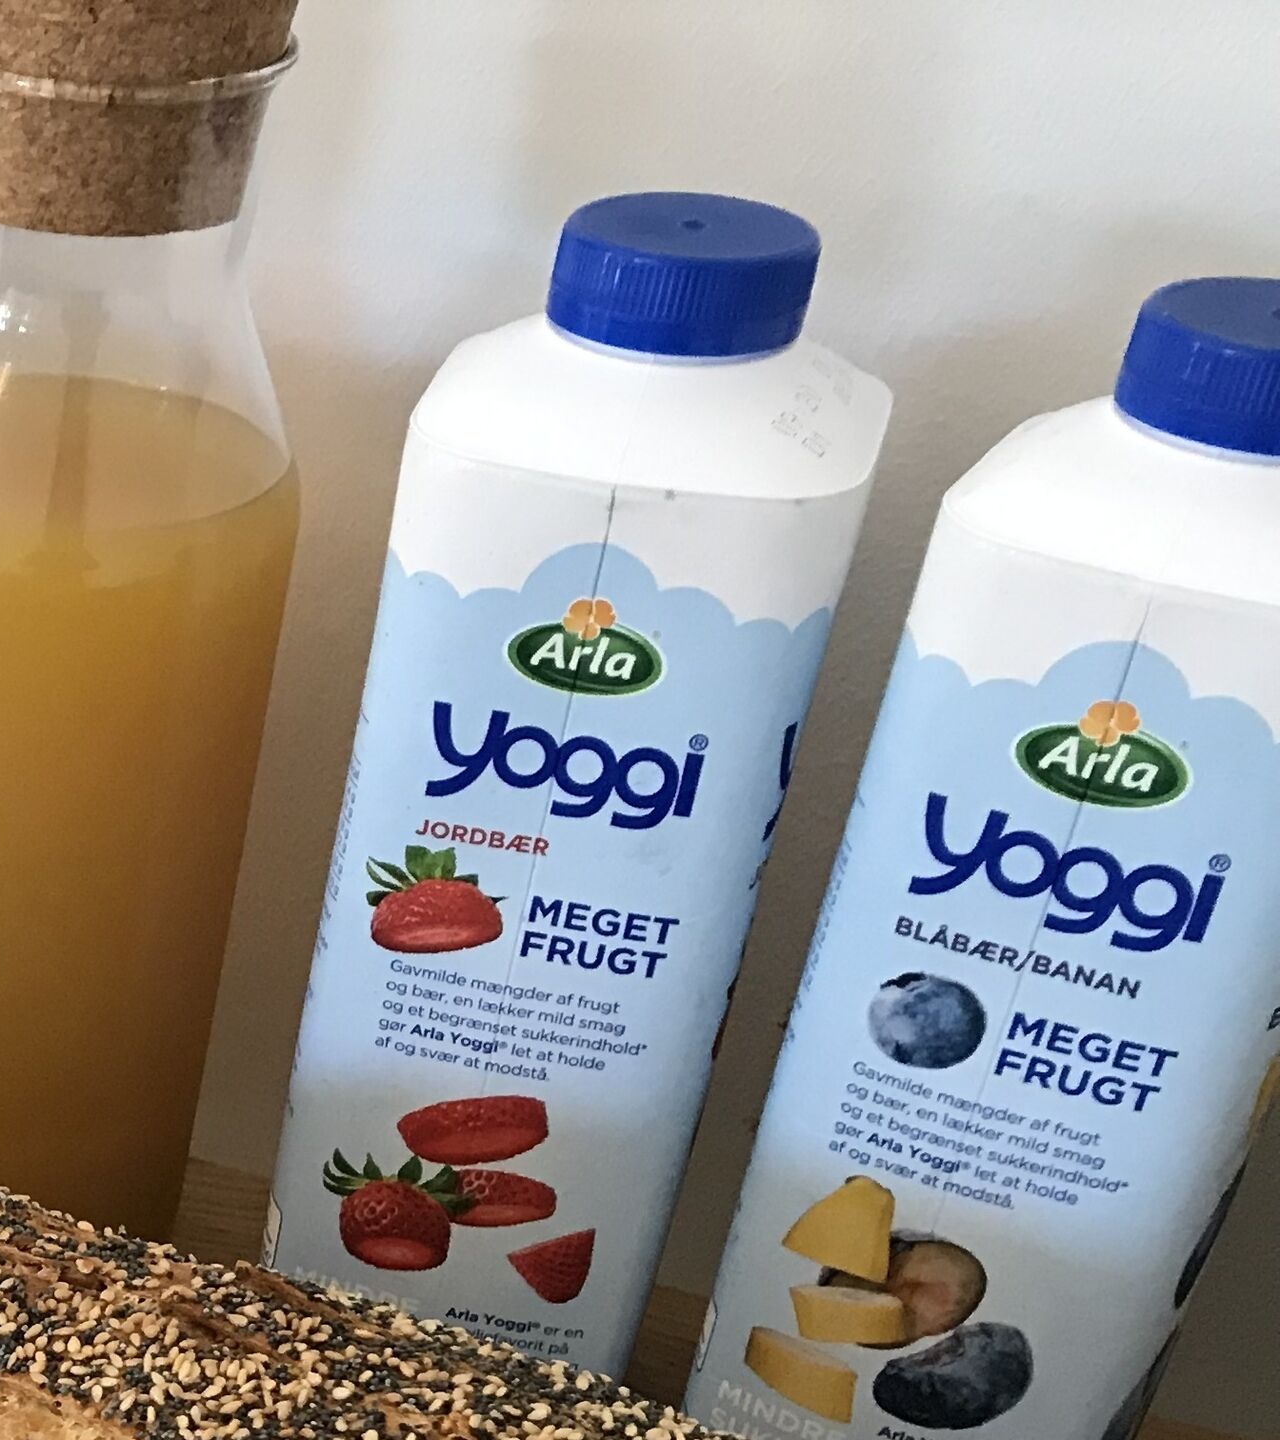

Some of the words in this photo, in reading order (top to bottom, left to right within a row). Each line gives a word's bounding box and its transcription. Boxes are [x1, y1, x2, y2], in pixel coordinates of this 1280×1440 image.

[529, 633, 638, 682] Arla
[1038, 735, 1160, 793] Arla
[415, 819, 550, 856] JORDBÆR
[527, 895, 680, 945] MEGET
[519, 932, 668, 979] FRUGT
[894, 915, 1143, 1000] BLÅBÆR/BANAN
[385, 981, 408, 996] og
[412, 984, 448, 1005] bær,
[453, 994, 473, 1008] en
[477, 997, 535, 1020] lækker
[538, 1009, 575, 1027] mild
[579, 1018, 626, 1037] smag
[390, 959, 467, 987] Gavmilde
[470, 976, 553, 1002] mængder
[556, 993, 575, 1006] af
[577, 997, 620, 1016] frugt
[378, 1018, 406, 1033] gør
[410, 1024, 445, 1042] Arla
[511, 1043, 532, 1059] let
[536, 1049, 554, 1063] at
[557, 1052, 606, 1071] holde
[382, 999, 403, 1015] og
[408, 1003, 425, 1018] et
[429, 1007, 517, 1037] begrænset
[1007, 1012, 1179, 1078] MEGET
[374, 1036, 393, 1048] af
[394, 1040, 416, 1056] og
[419, 1046, 461, 1064] svær
[463, 1055, 481, 1070] at
[484, 1060, 549, 1082] modstå.
[993, 1047, 1162, 1112] FRUGT
[840, 1101, 863, 1120] og
[866, 1108, 885, 1126] et
[887, 1116, 984, 1159] begrænset
[846, 1082, 869, 1101] og
[871, 1087, 911, 1116] bær,
[916, 1106, 938, 1123] en
[941, 1112, 1005, 1141] lækker
[1008, 1132, 1049, 1155] mild
[1052, 1146, 1106, 1171] smag
[853, 1060, 933, 1100] Gavmilde
[936, 1090, 1026, 1126] mængder
[1029, 1117, 1050, 1133] af
[1053, 1122, 1102, 1147] frugt
[828, 1138, 847, 1153] af
[848, 1147, 871, 1166] og
[874, 1157, 918, 1180] svær
[920, 1172, 940, 1188] at
[942, 1180, 1015, 1210] modstå.
[834, 1121, 864, 1140] gør
[867, 1131, 904, 1154] Arla
[973, 1164, 997, 1184] let
[1001, 1172, 1021, 1190] at
[1024, 1179, 1079, 1206] holde
[445, 1307, 479, 1323] Arla
[543, 1324, 561, 1336] er
[565, 1327, 585, 1339] en
[547, 1343, 570, 1356] på
